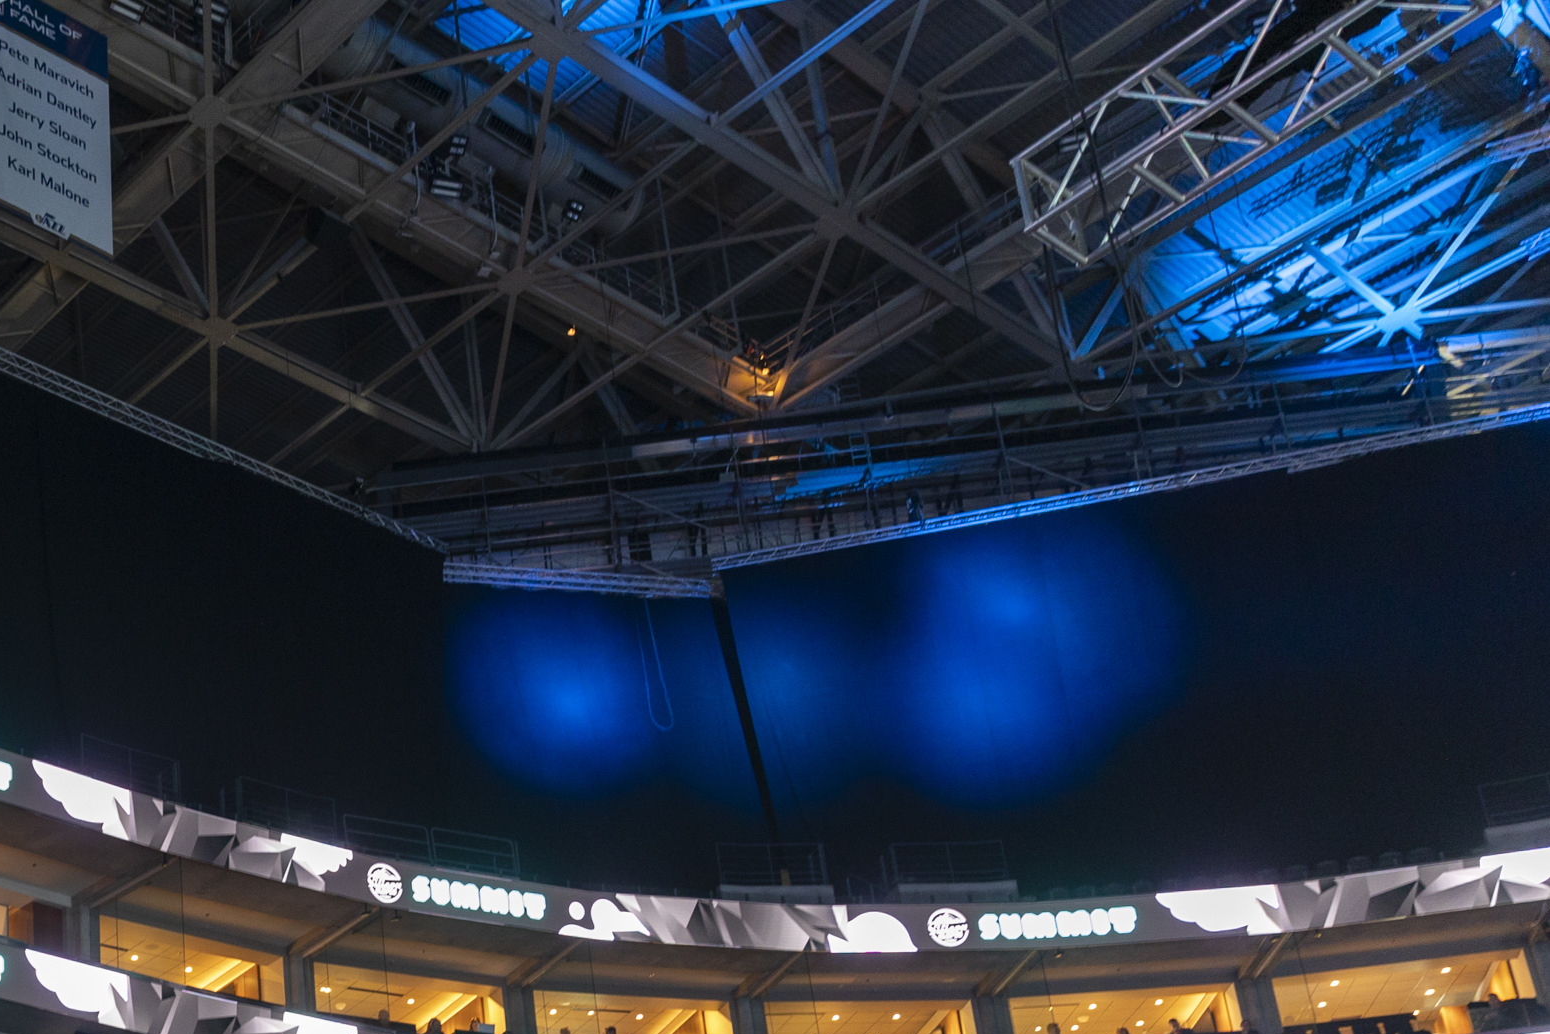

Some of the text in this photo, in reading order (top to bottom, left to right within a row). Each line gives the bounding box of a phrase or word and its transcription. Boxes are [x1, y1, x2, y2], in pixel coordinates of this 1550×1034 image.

[10, 0, 83, 40] HALL OF
[10, 8, 56, 41] FAME
[34, 57, 94, 99] Maravich
[9, 101, 87, 150] Jerry Sloan
[47, 92, 97, 130] Dantley
[7, 156, 90, 208] Karl Malone
[37, 143, 97, 184] Stockton
[411, 875, 546, 920] SUMMIT
[979, 906, 1138, 940] SUMMIT
